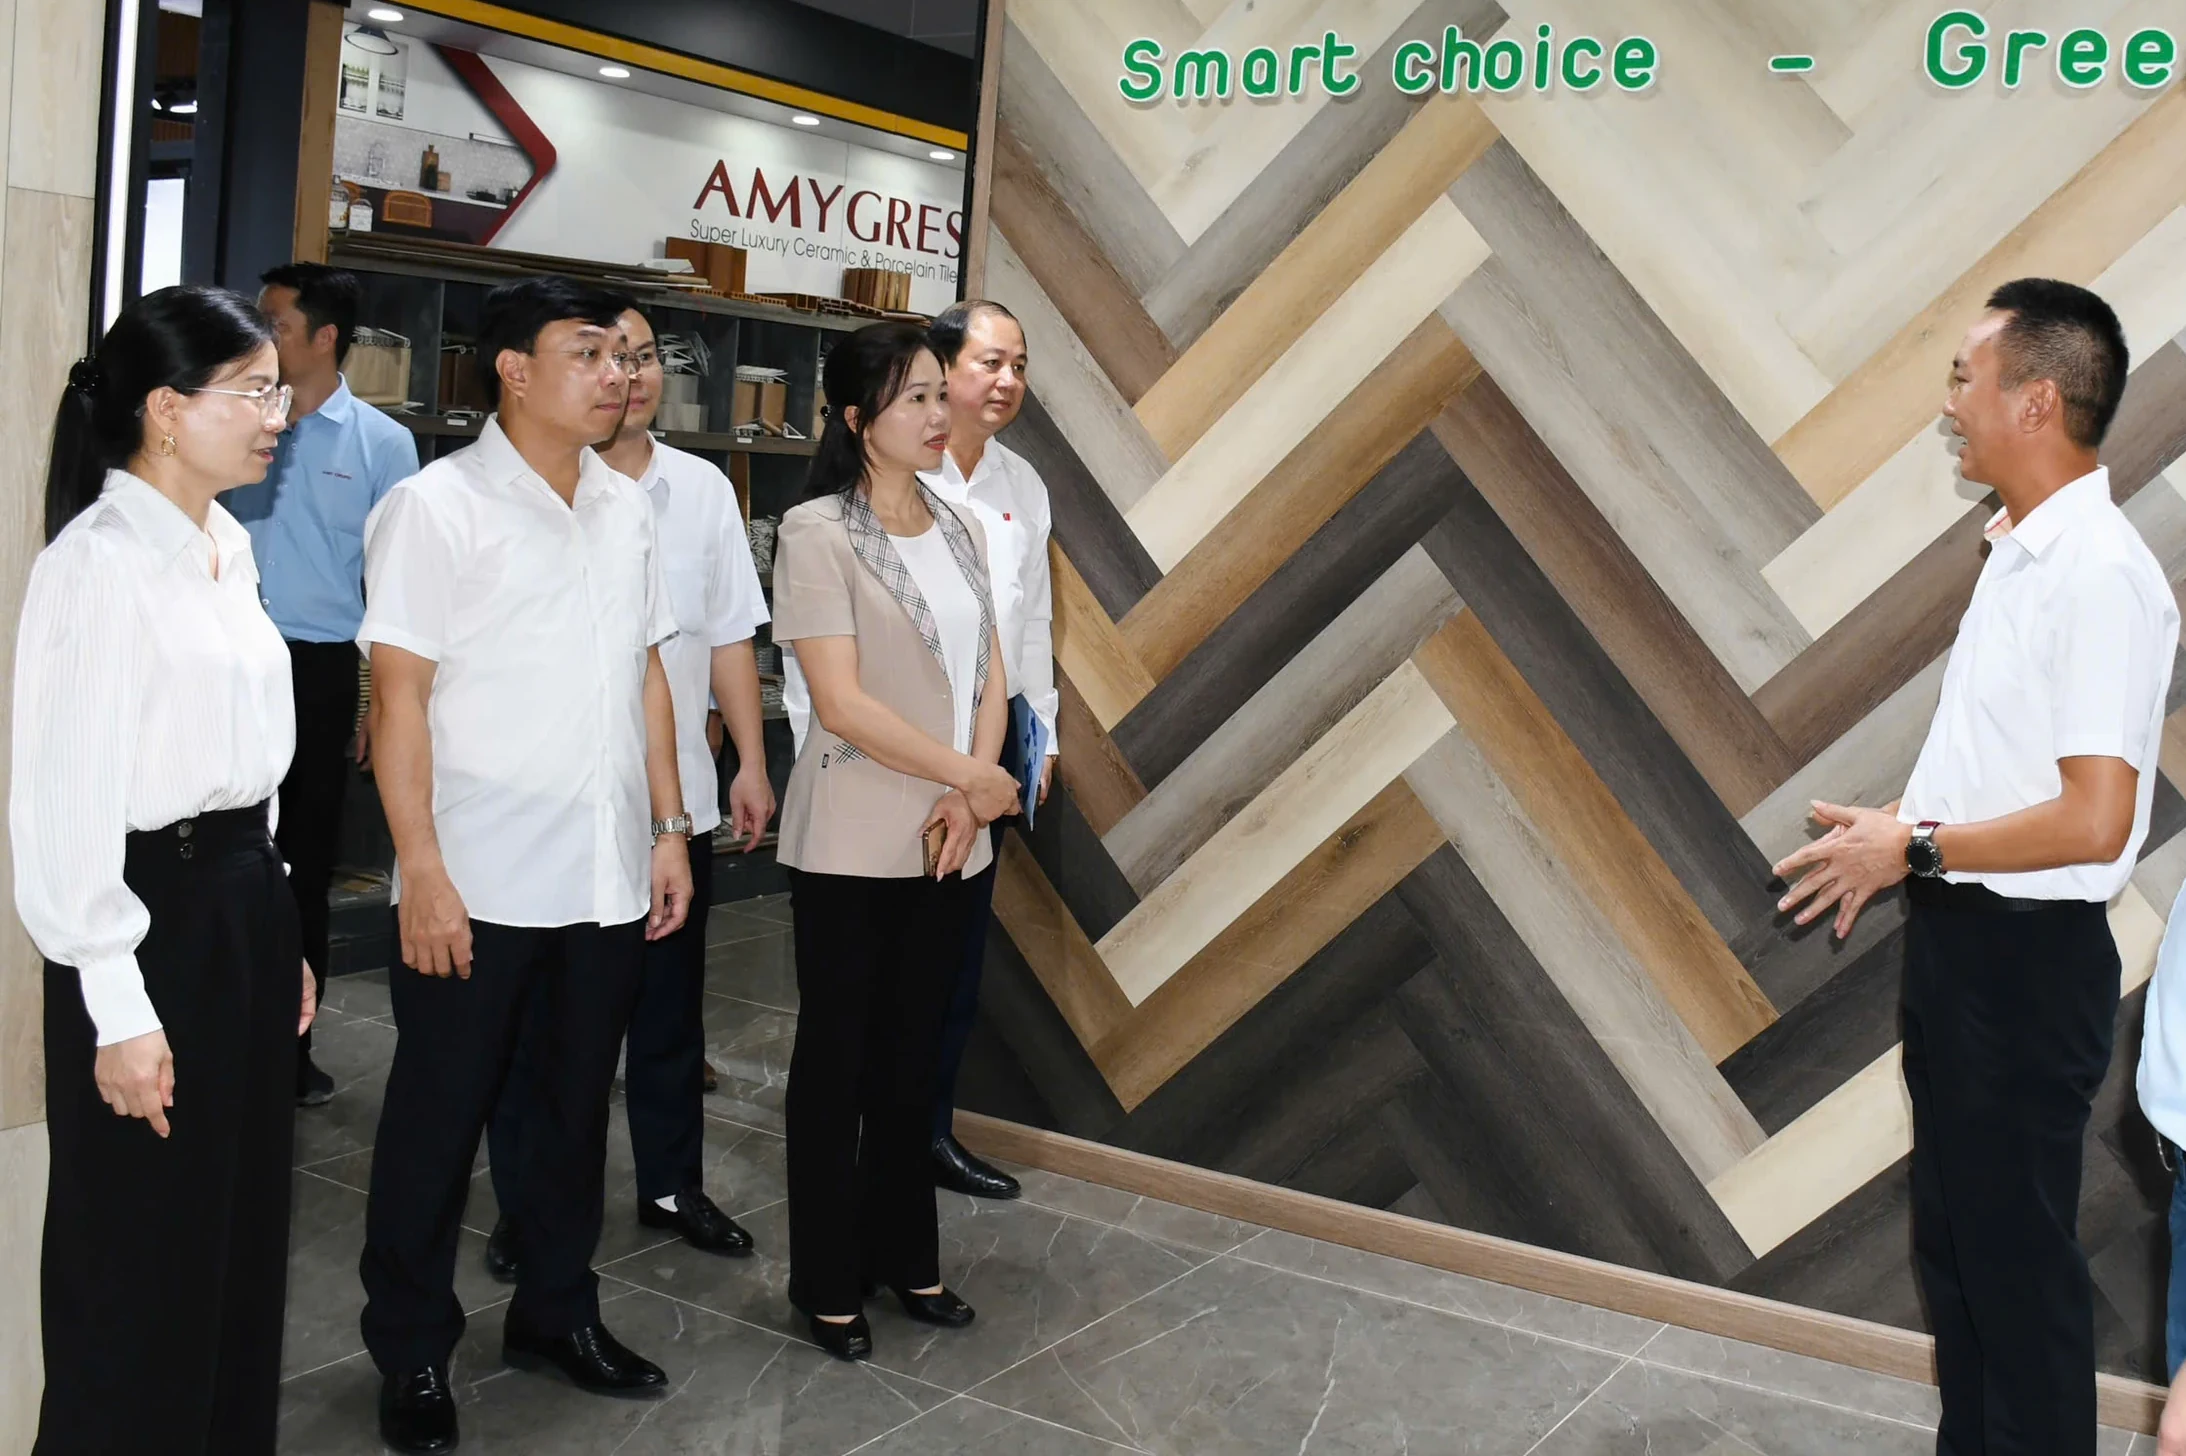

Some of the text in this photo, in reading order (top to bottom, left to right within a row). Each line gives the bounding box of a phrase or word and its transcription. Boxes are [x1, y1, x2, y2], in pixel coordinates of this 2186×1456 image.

[1119, 30, 1359, 101] Smart
[1393, 24, 1658, 94] choice
[1925, 10, 2177, 89] Gree
[690, 218, 958, 284] Super Luxury Ceramic & Porcelain Tile
[693, 159, 963, 260] AMYGRES
